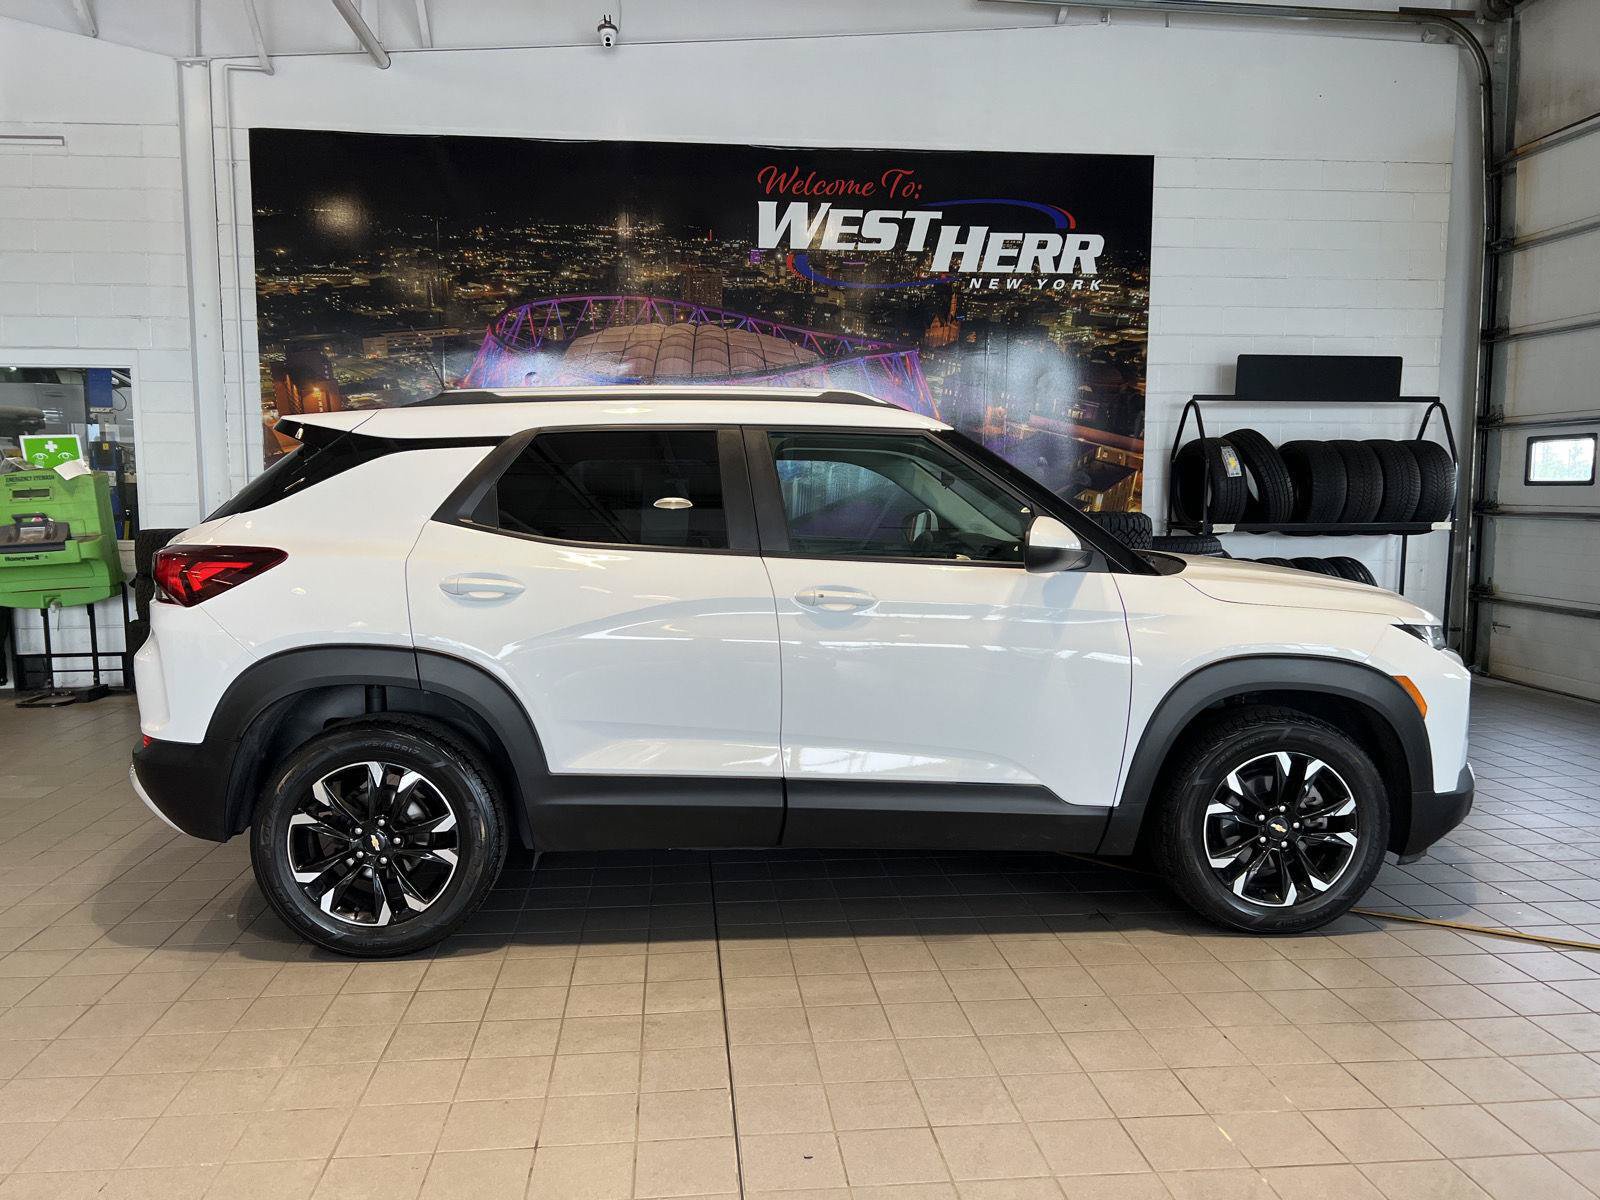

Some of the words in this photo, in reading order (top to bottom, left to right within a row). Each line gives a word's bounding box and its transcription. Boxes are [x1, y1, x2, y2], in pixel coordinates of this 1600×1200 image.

[757, 165, 876, 197] Welcome
[881, 168, 922, 199] To:
[969, 278, 1023, 290] NEW
[1036, 278, 1102, 291] YORK
[4, 554, 40, 562] Honeywell
